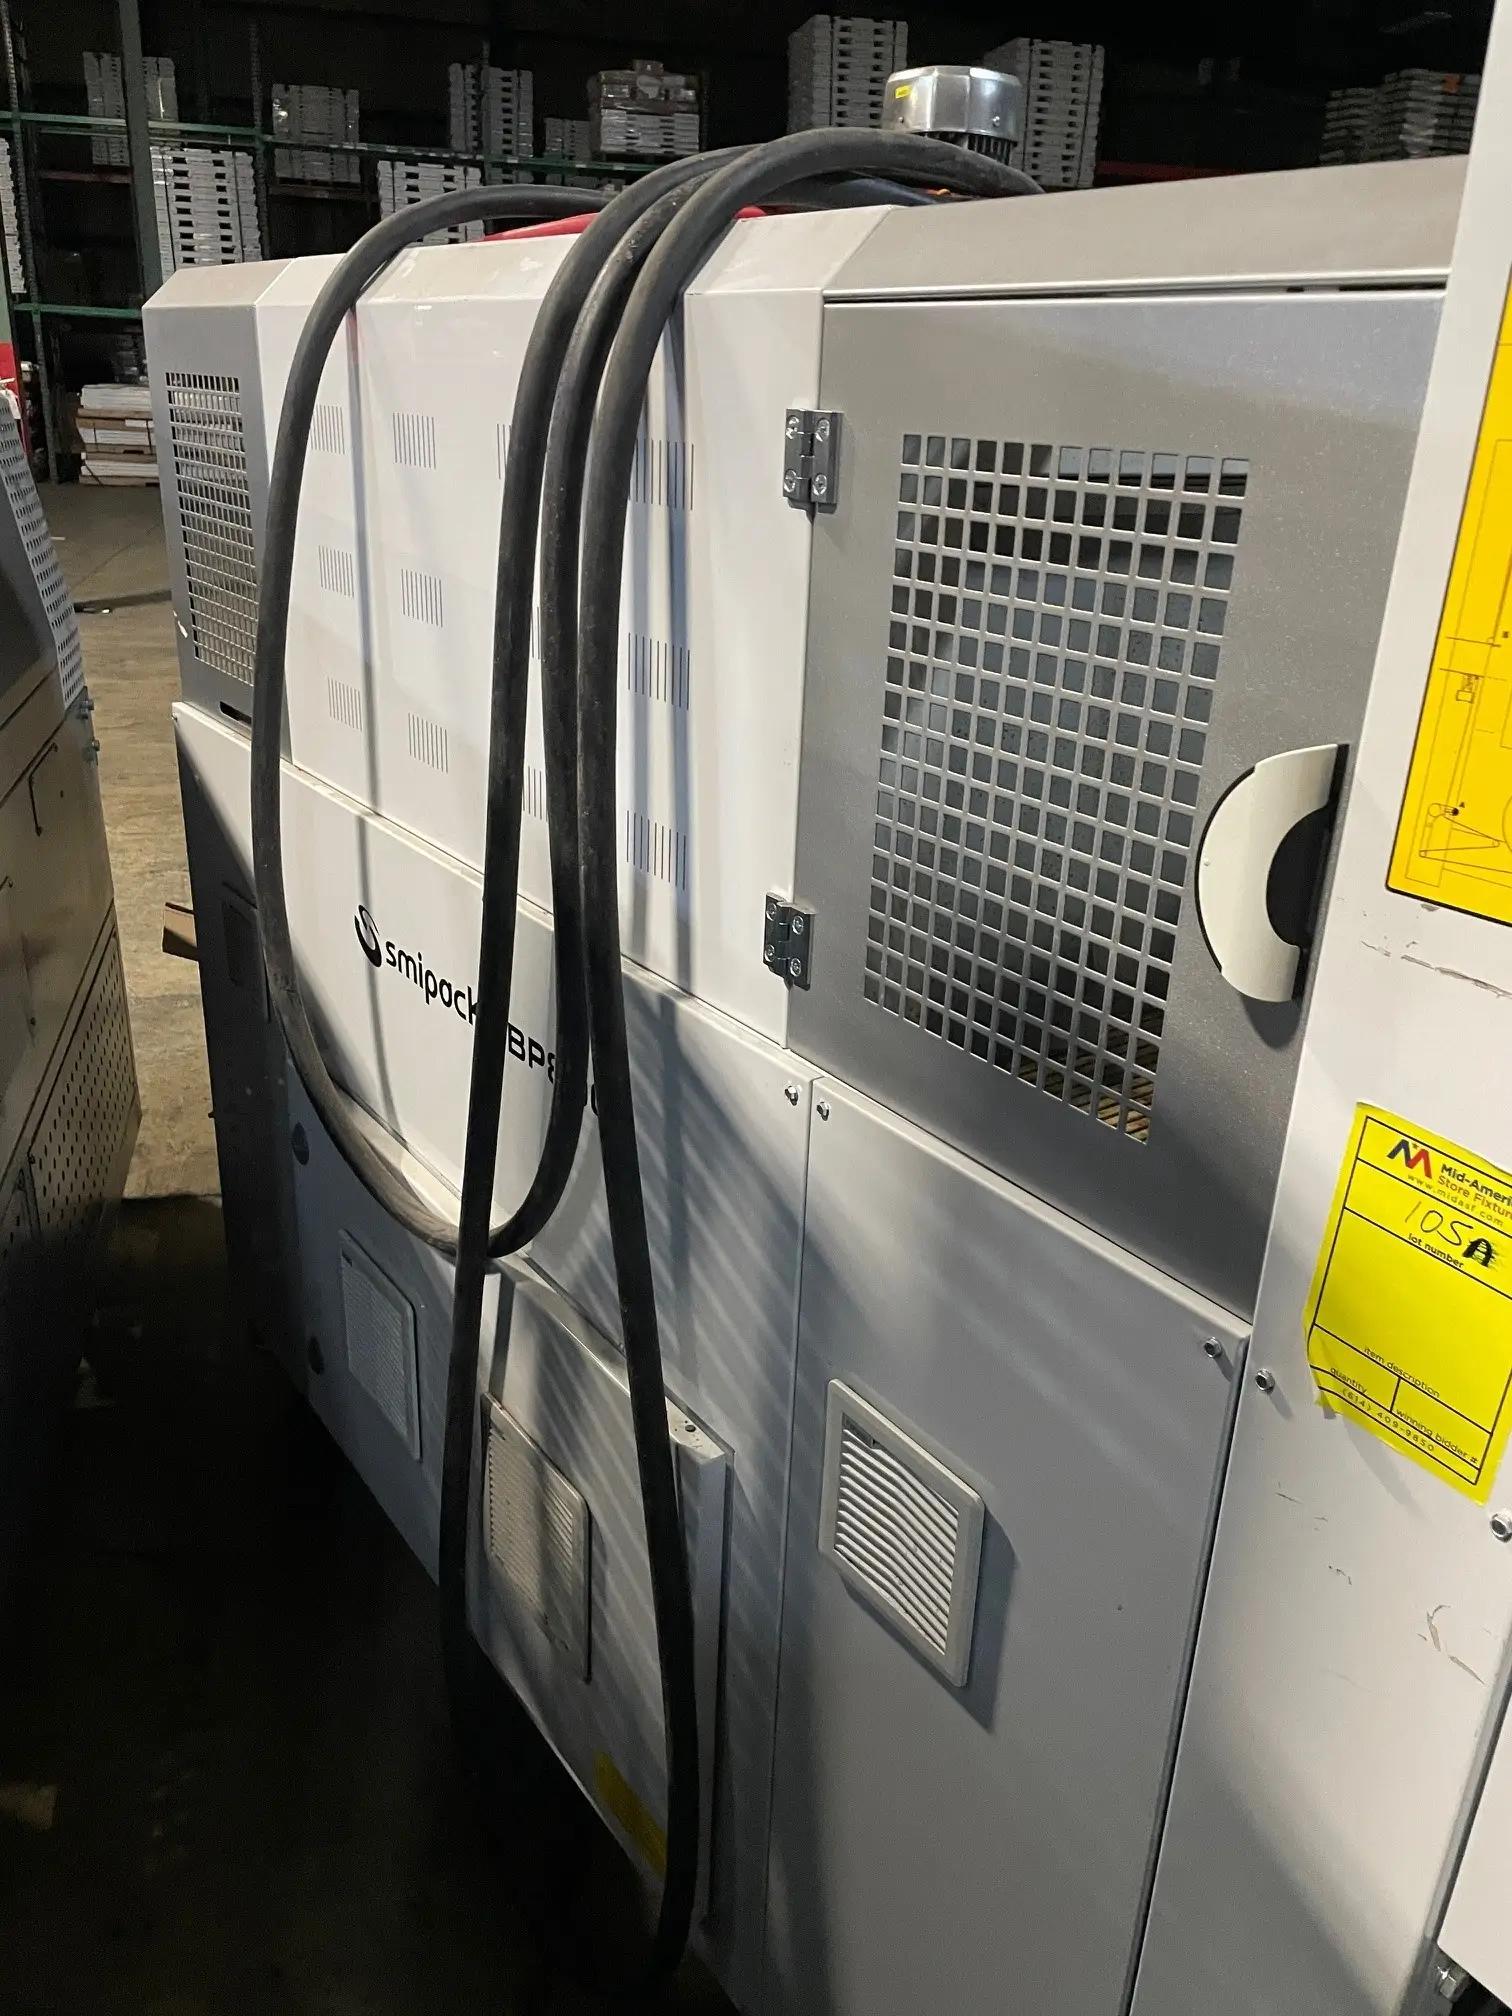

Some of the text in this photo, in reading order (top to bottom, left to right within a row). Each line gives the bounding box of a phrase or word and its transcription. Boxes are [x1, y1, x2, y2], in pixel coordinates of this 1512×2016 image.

[1438, 1175, 1512, 1221] Store Fixtur
[1408, 1233, 1465, 1268] lot number
[1329, 1367, 1367, 1394] quantity
[1364, 1347, 1440, 1398] item description
[1396, 1408, 1433, 1437] winning
[1435, 1432, 1468, 1457] bidder
